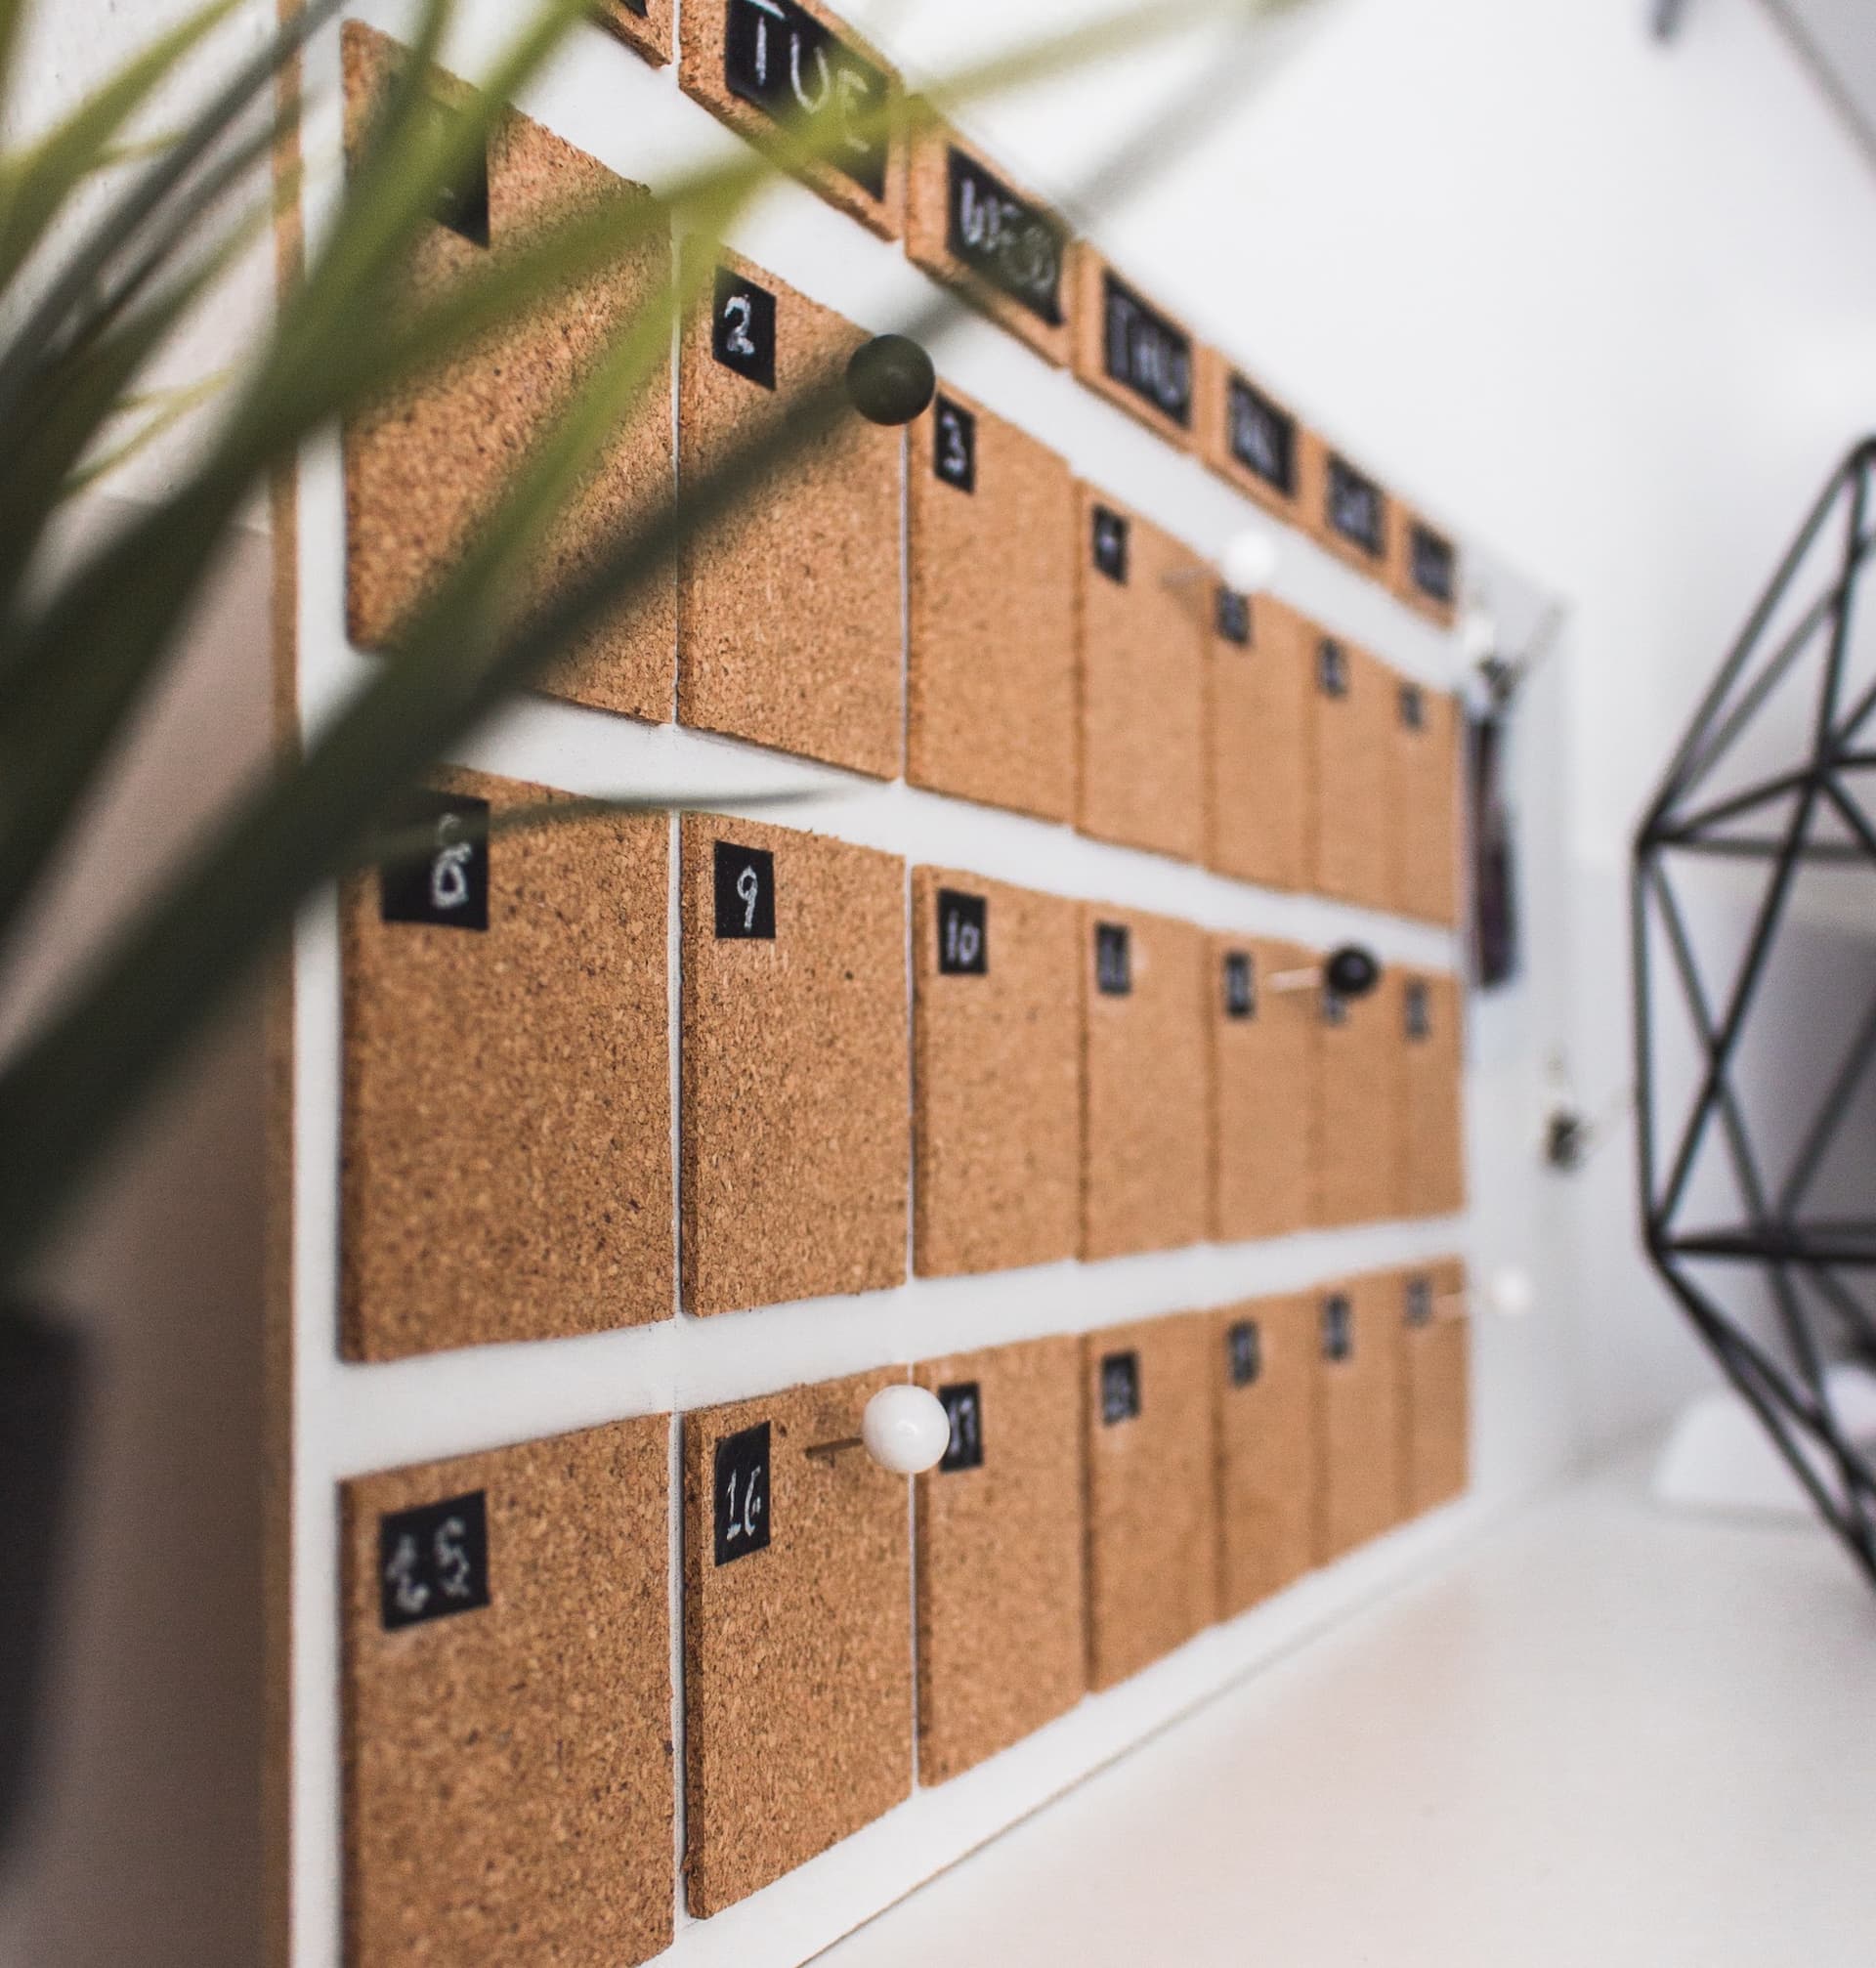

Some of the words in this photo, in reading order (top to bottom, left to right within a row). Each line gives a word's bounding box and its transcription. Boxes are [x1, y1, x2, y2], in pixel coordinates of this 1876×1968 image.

[741, 0, 870, 153] TUE
[723, 293, 755, 356] 2
[941, 409, 966, 477] 3
[736, 865, 758, 932] 9
[946, 907, 980, 965] 10
[726, 1465, 761, 1541] 16
